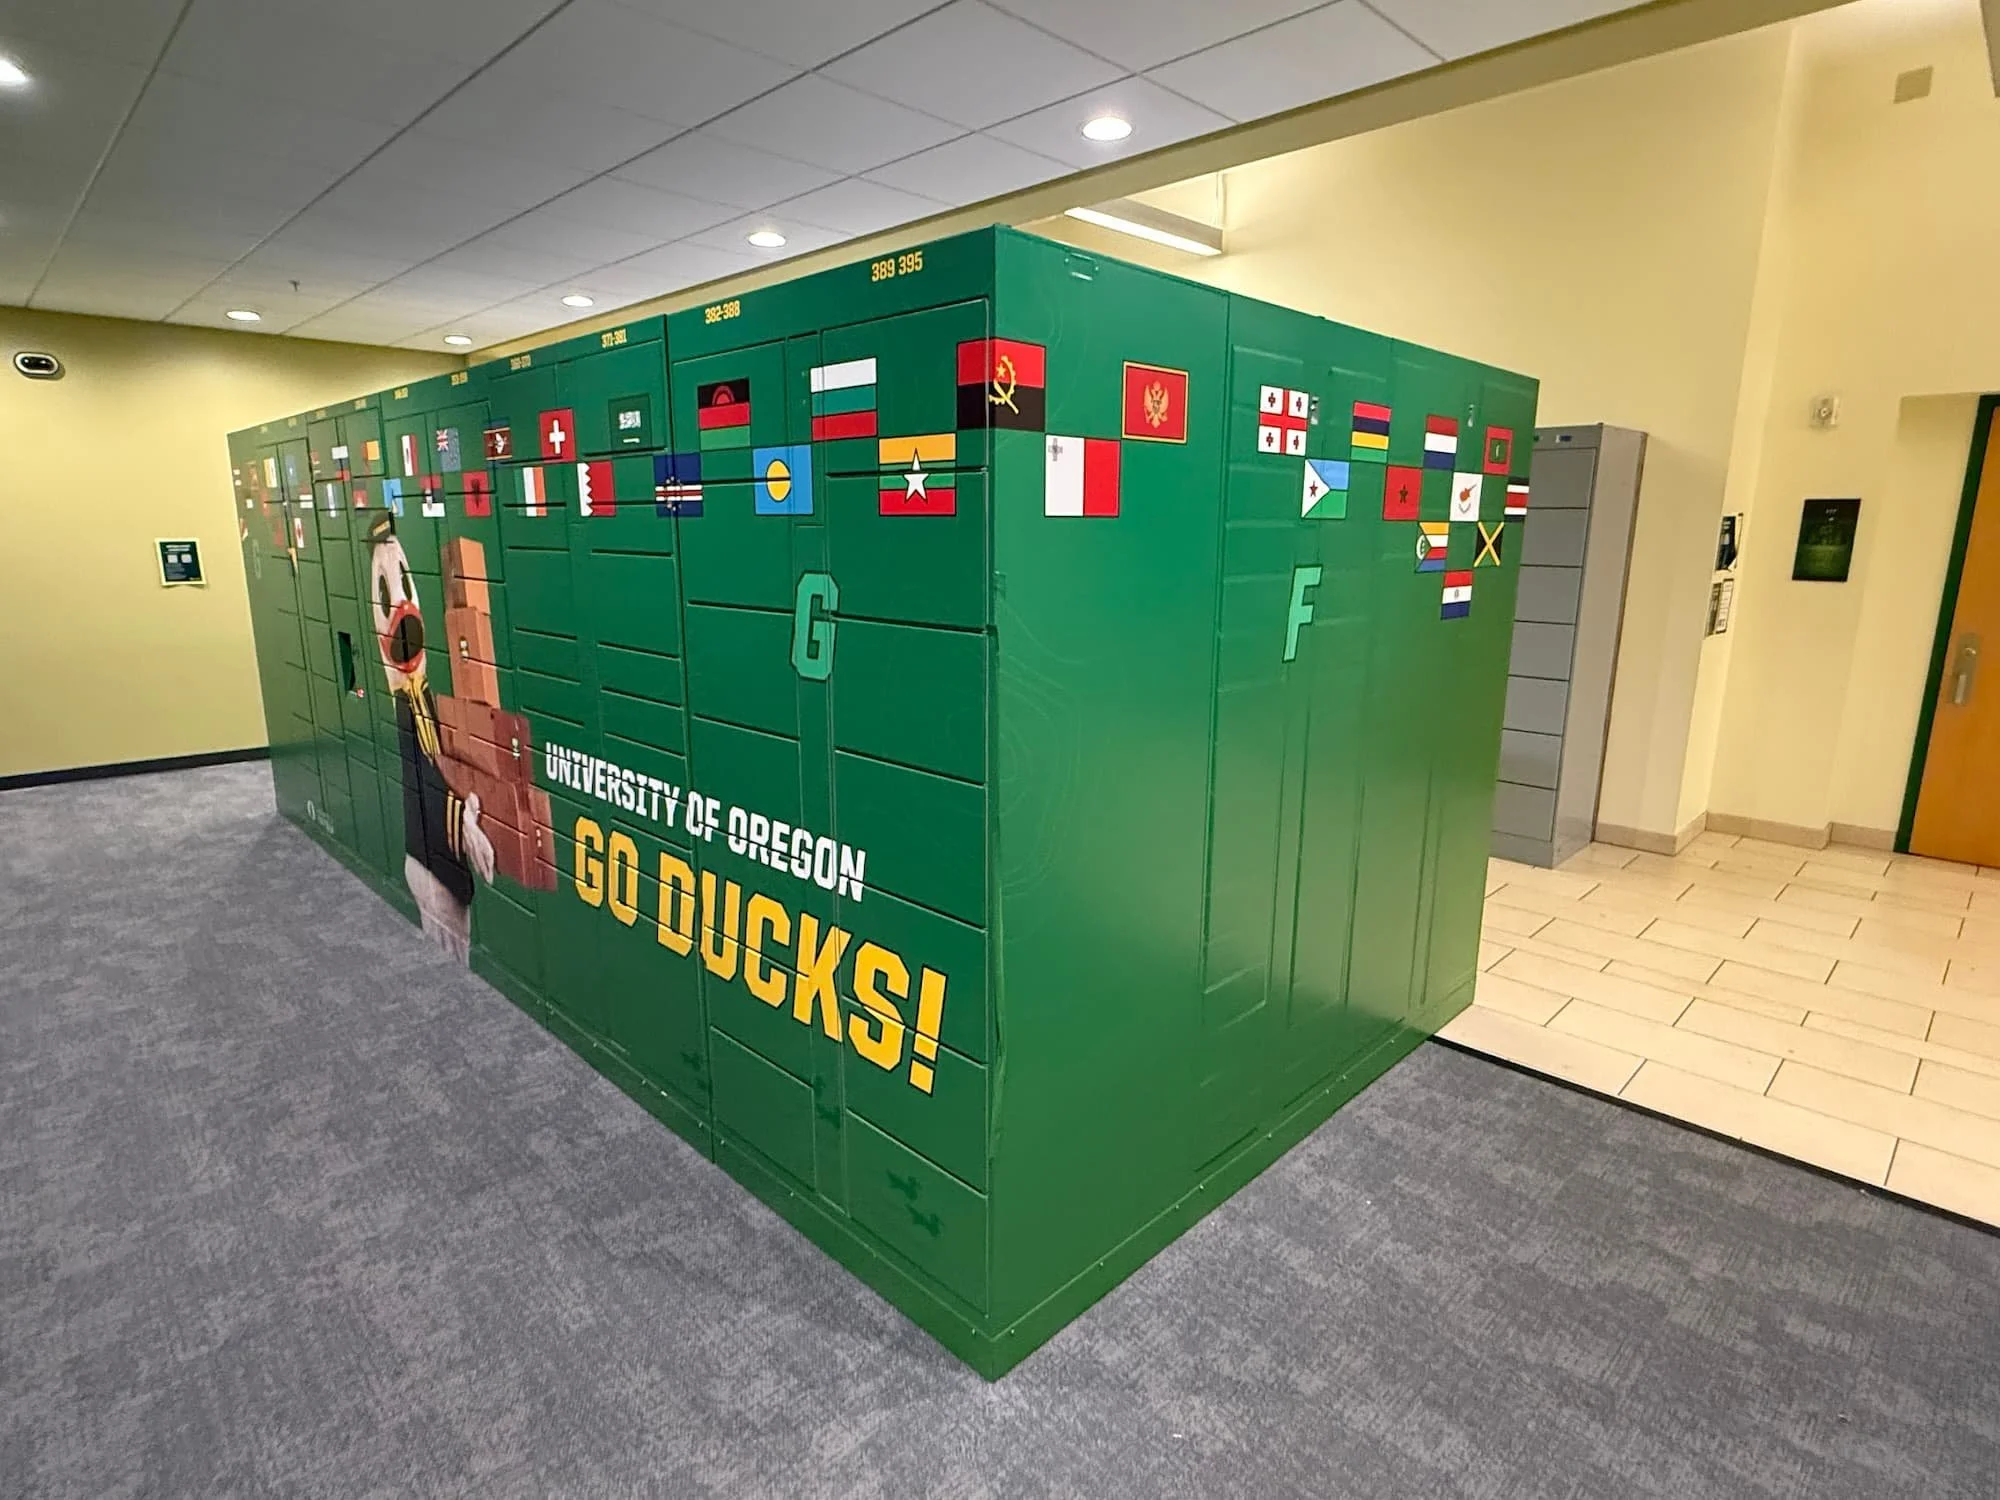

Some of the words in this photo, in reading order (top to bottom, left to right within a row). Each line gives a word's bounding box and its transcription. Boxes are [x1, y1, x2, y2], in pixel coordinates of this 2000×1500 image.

[704, 300, 741, 324] 382-388
[871, 258, 895, 282] 389
[898, 250, 923, 275] 395
[790, 570, 840, 683] G
[1282, 564, 1323, 663] F
[545, 741, 680, 828] UNIVERSITY
[685, 790, 721, 843] OF
[727, 805, 867, 902] OREGON
[573, 815, 640, 928] GO
[656, 850, 947, 1097] DUCKS!
